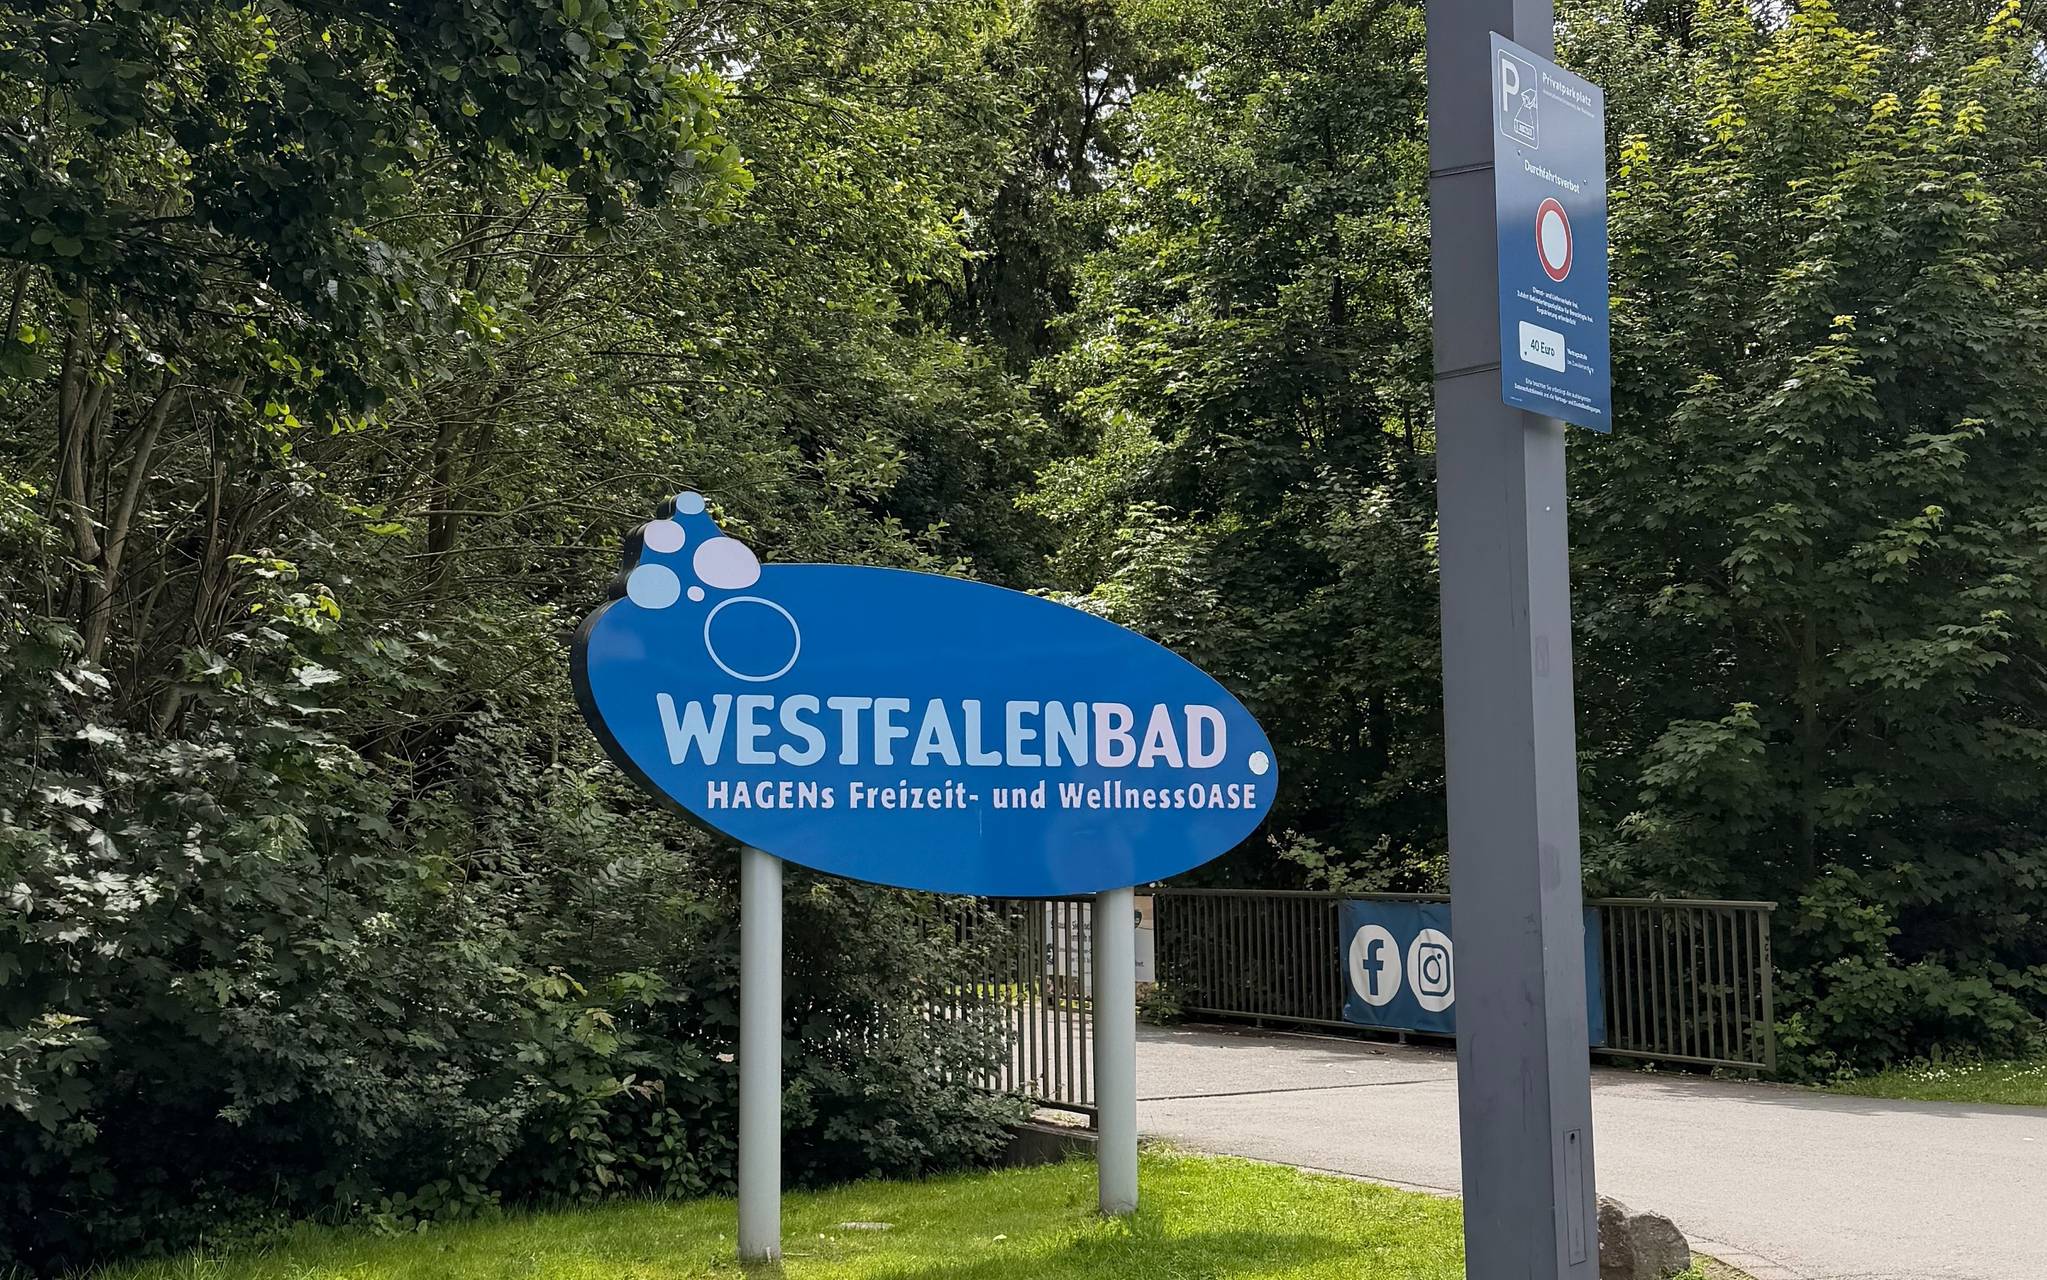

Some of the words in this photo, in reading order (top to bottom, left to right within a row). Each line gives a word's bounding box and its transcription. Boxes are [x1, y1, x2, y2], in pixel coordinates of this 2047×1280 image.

[1502, 58, 1520, 112] P
[1542, 72, 1592, 108] Privatparkplatz
[1524, 159, 1580, 194] Durchfahrtsverbot
[1530, 338, 1540, 352] 40
[1540, 342, 1556, 357] Euro
[656, 693, 1227, 768] WESTFALENBAD
[707, 780, 835, 809] HAGENs
[850, 779, 979, 810] Freizeit-
[993, 780, 1046, 809] und
[1058, 780, 1257, 810] WellnessOASE
